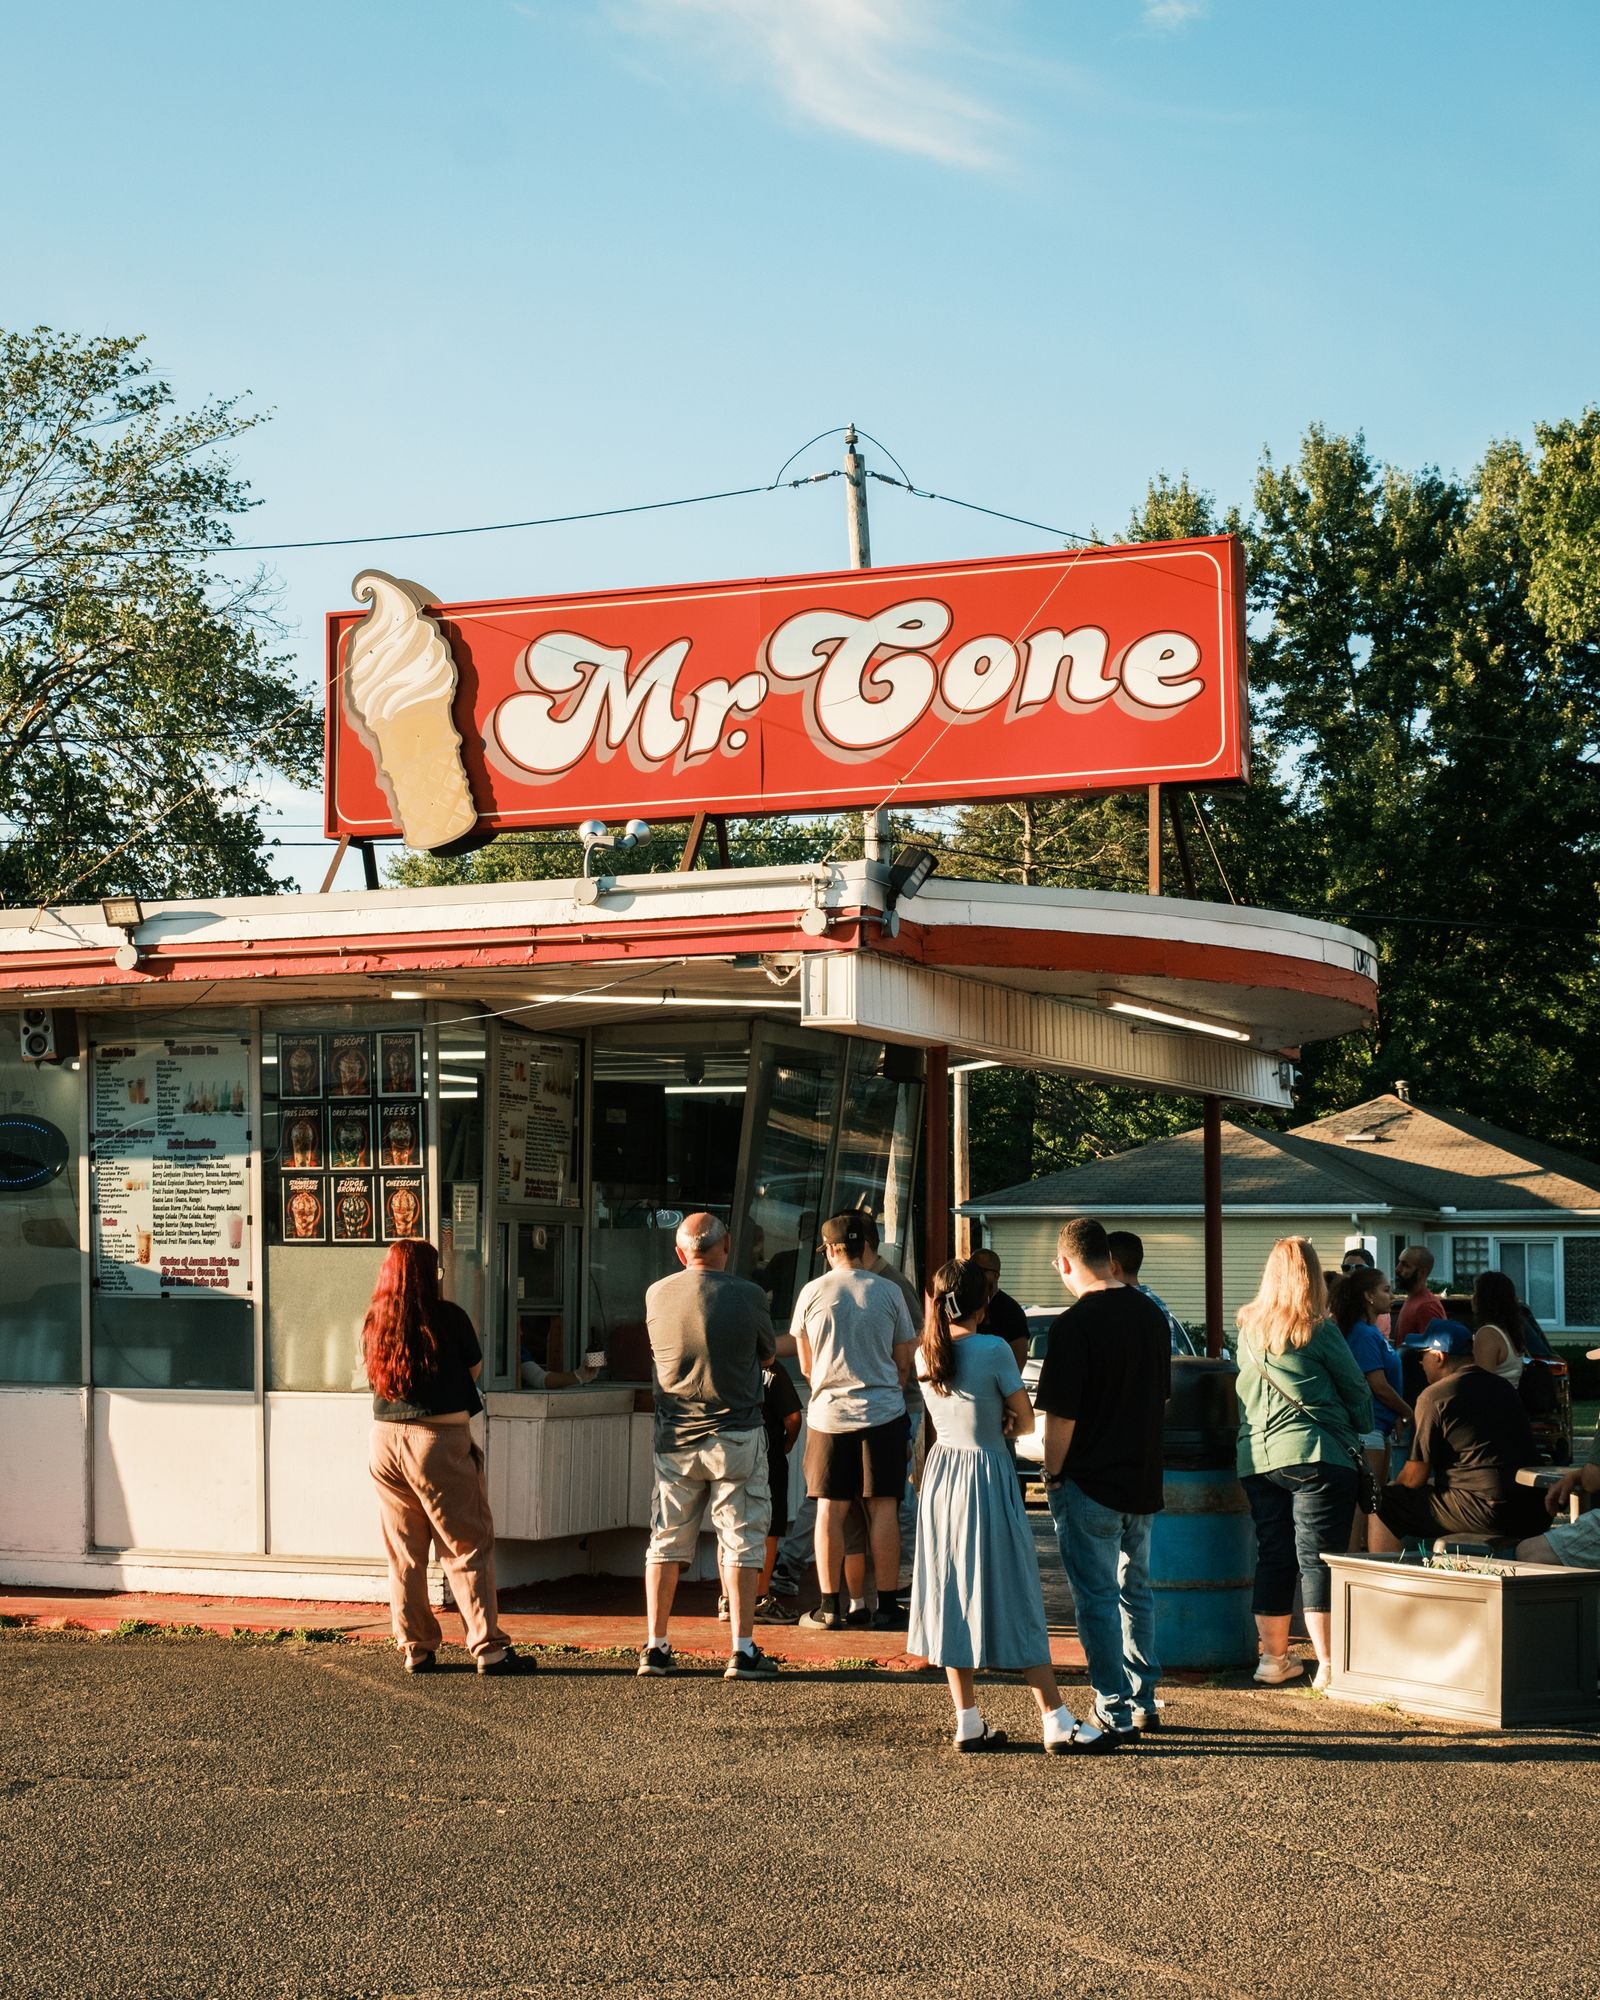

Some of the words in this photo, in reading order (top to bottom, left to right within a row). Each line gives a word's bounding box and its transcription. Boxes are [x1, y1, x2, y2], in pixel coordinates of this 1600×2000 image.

[491, 628, 770, 775] Mr.
[764, 594, 1206, 754] Cone
[333, 1036, 366, 1048] BISCOFF
[332, 1109, 346, 1117] OREO
[383, 1106, 416, 1116] REESE'S
[385, 1179, 420, 1187] CHEESECAKE
[336, 1185, 368, 1193] BROWNIE
[160, 1257, 180, 1266] Choice
[181, 1257, 188, 1266] of
[188, 1257, 208, 1266] Assam
[209, 1257, 226, 1266] Black
[227, 1257, 240, 1266] Tea
